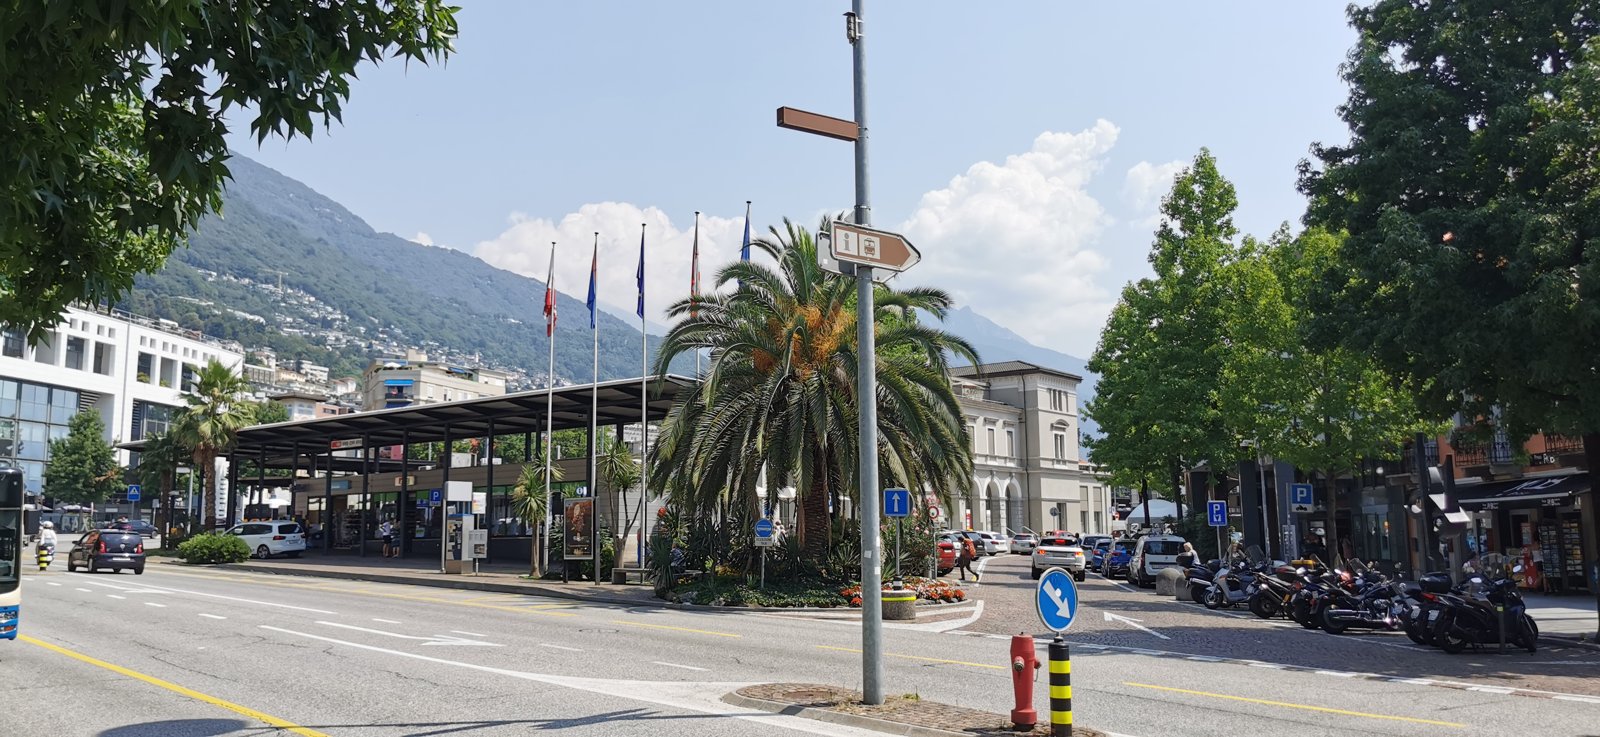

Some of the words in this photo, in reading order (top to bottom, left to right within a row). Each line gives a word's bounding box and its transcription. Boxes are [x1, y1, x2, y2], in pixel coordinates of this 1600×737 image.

[433, 491, 439, 500] P
[1297, 487, 1307, 502] P
[1213, 503, 1220, 513] P
